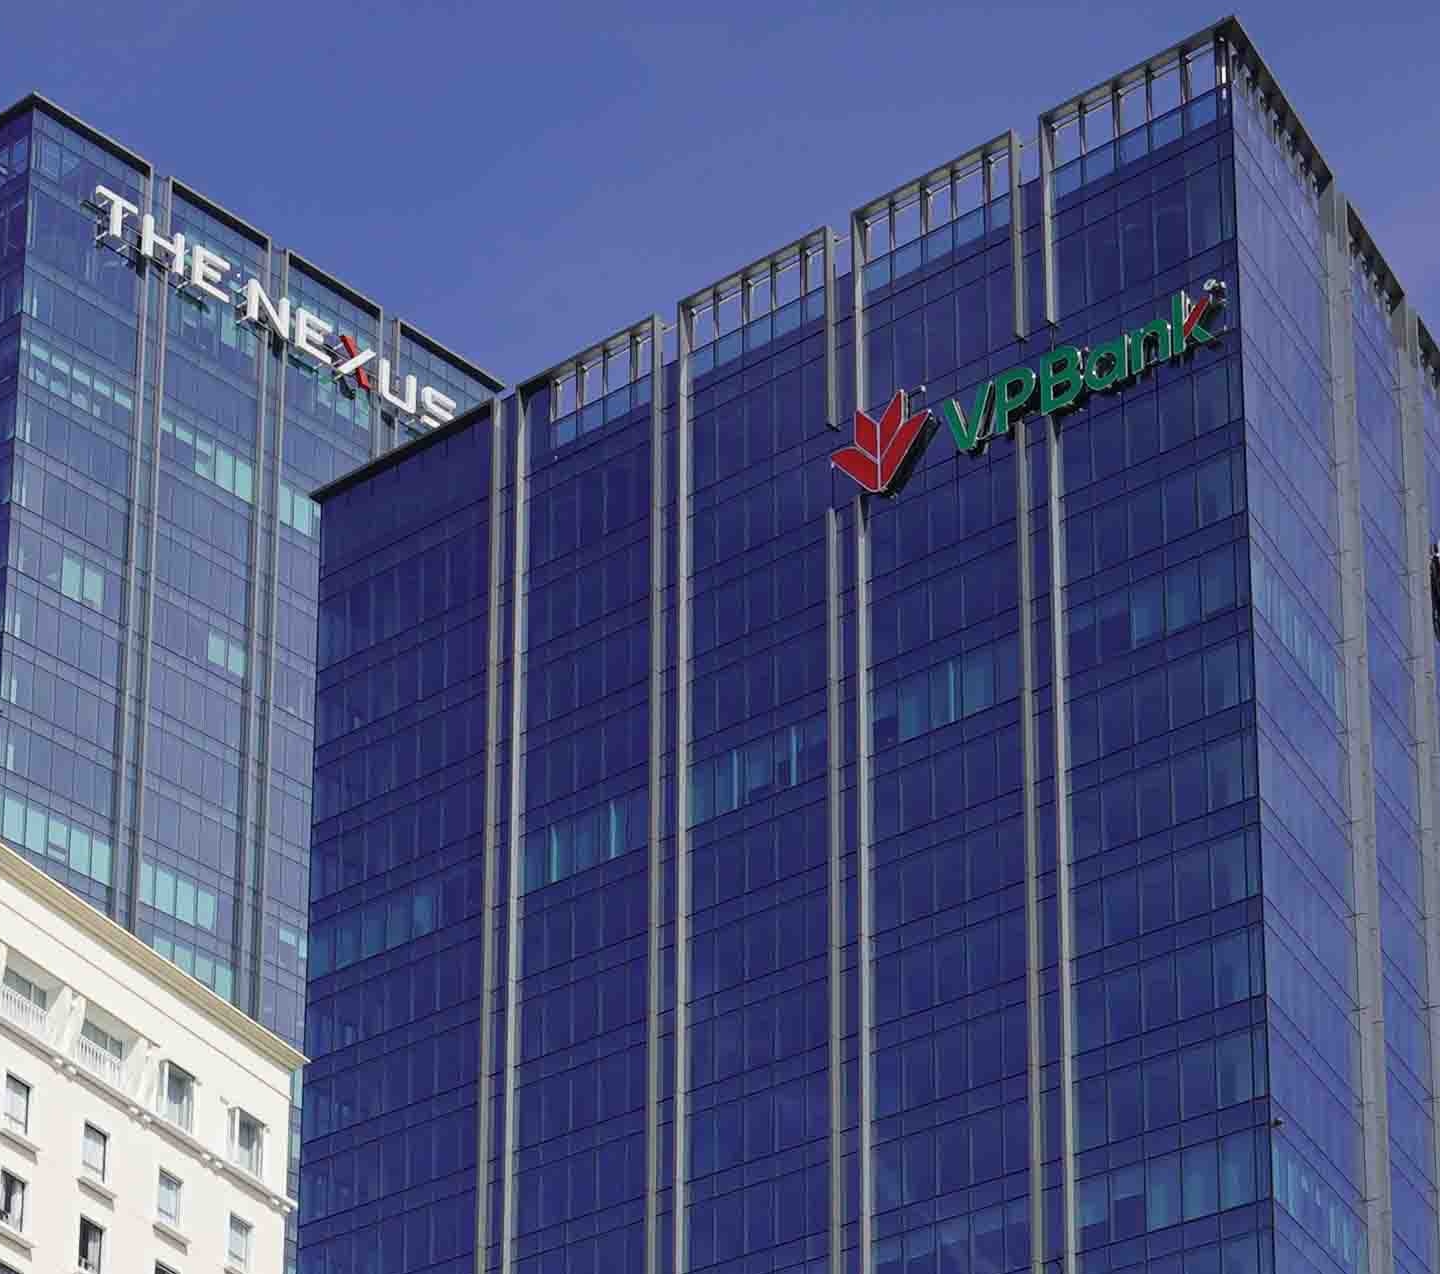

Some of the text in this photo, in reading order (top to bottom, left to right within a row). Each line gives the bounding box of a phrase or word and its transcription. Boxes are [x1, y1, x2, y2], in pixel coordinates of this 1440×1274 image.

[95, 184, 457, 428] THE NEXUS
[943, 289, 1216, 451] VPBank
